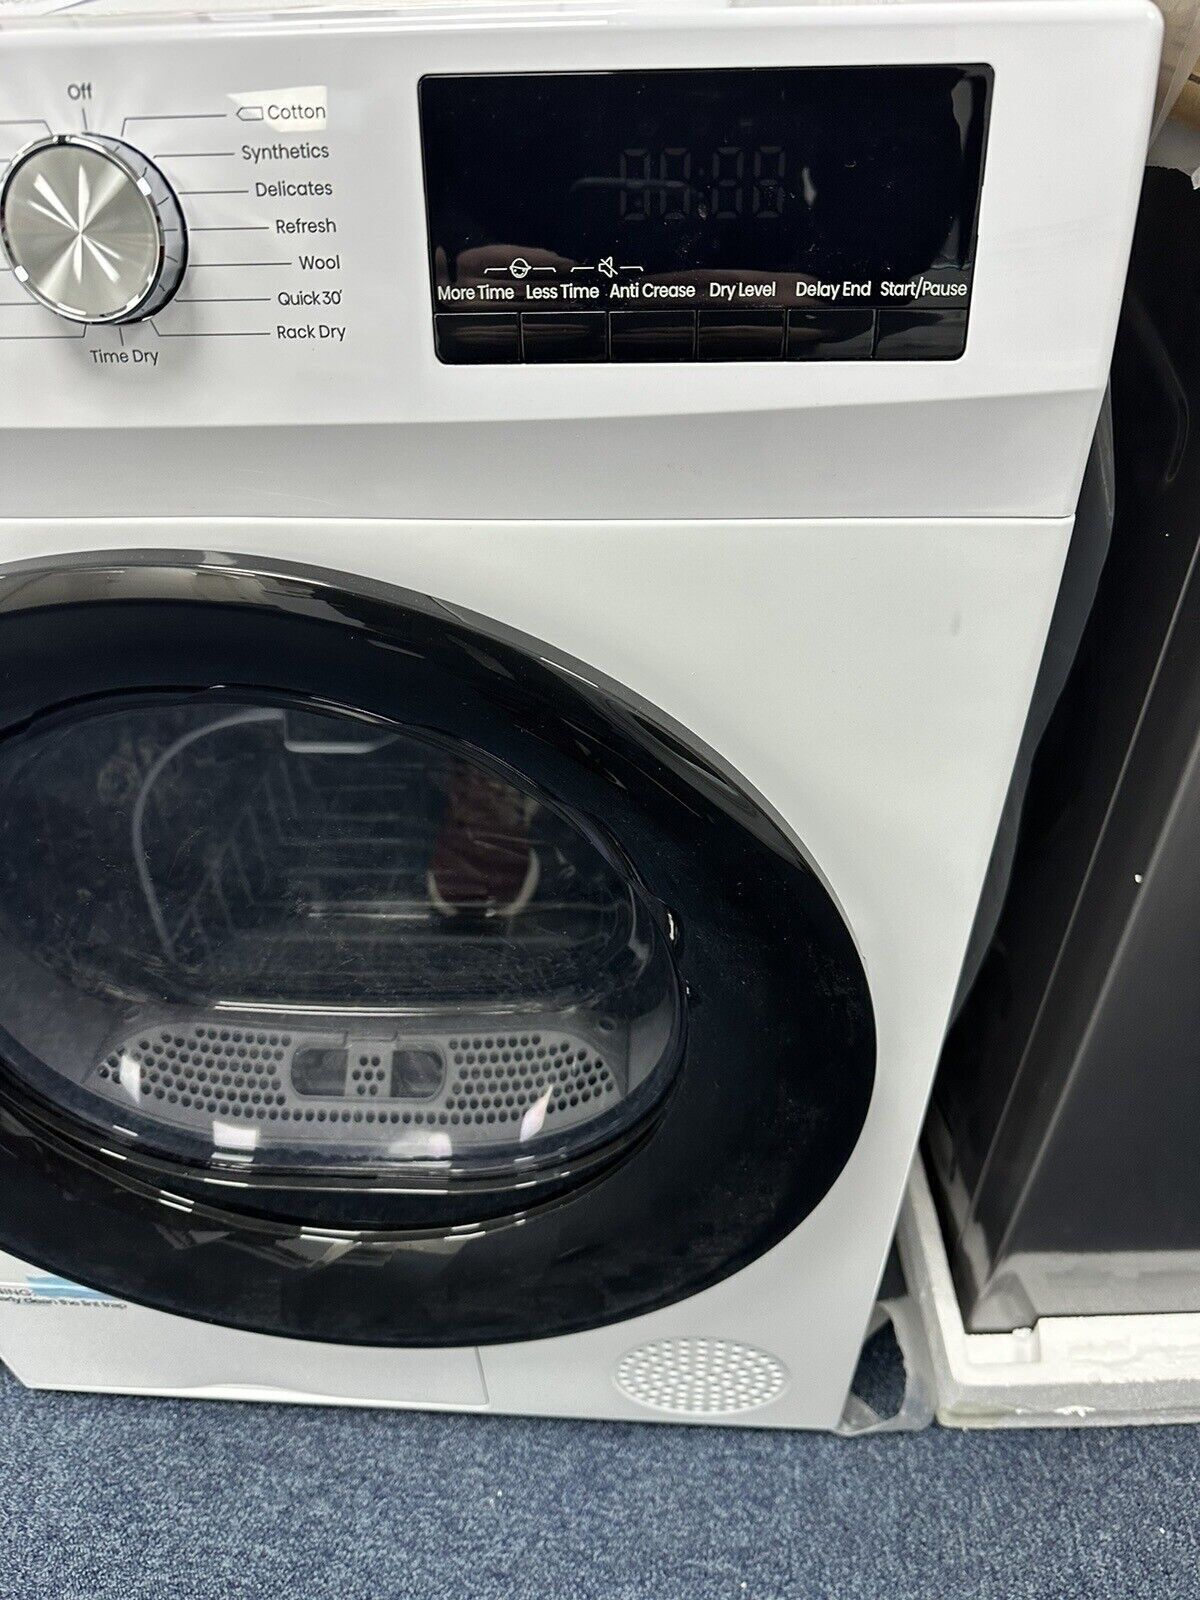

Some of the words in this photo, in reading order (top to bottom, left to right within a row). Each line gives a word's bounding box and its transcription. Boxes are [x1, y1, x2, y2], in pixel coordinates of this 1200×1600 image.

[67, 83, 92, 101] Off
[267, 103, 326, 120] Cotton
[241, 142, 330, 164] Synthetics
[255, 180, 333, 198] Delicates
[275, 217, 337, 234] Refresh
[298, 254, 341, 270] Wool
[437, 285, 475, 300] More
[476, 284, 515, 300] Time
[525, 284, 558, 300] Less
[559, 282, 600, 299] Time
[609, 282, 640, 299] Anti
[642, 282, 696, 298] Crease
[709, 282, 737, 301] Dry
[738, 281, 776, 297] Level
[795, 281, 841, 301] Delay
[842, 281, 872, 297] End
[880, 277, 968, 300] Start/Pause
[276, 324, 316, 340] Rack
[318, 324, 346, 342] Dry
[90, 348, 130, 364] Time
[132, 348, 159, 366] Dry
